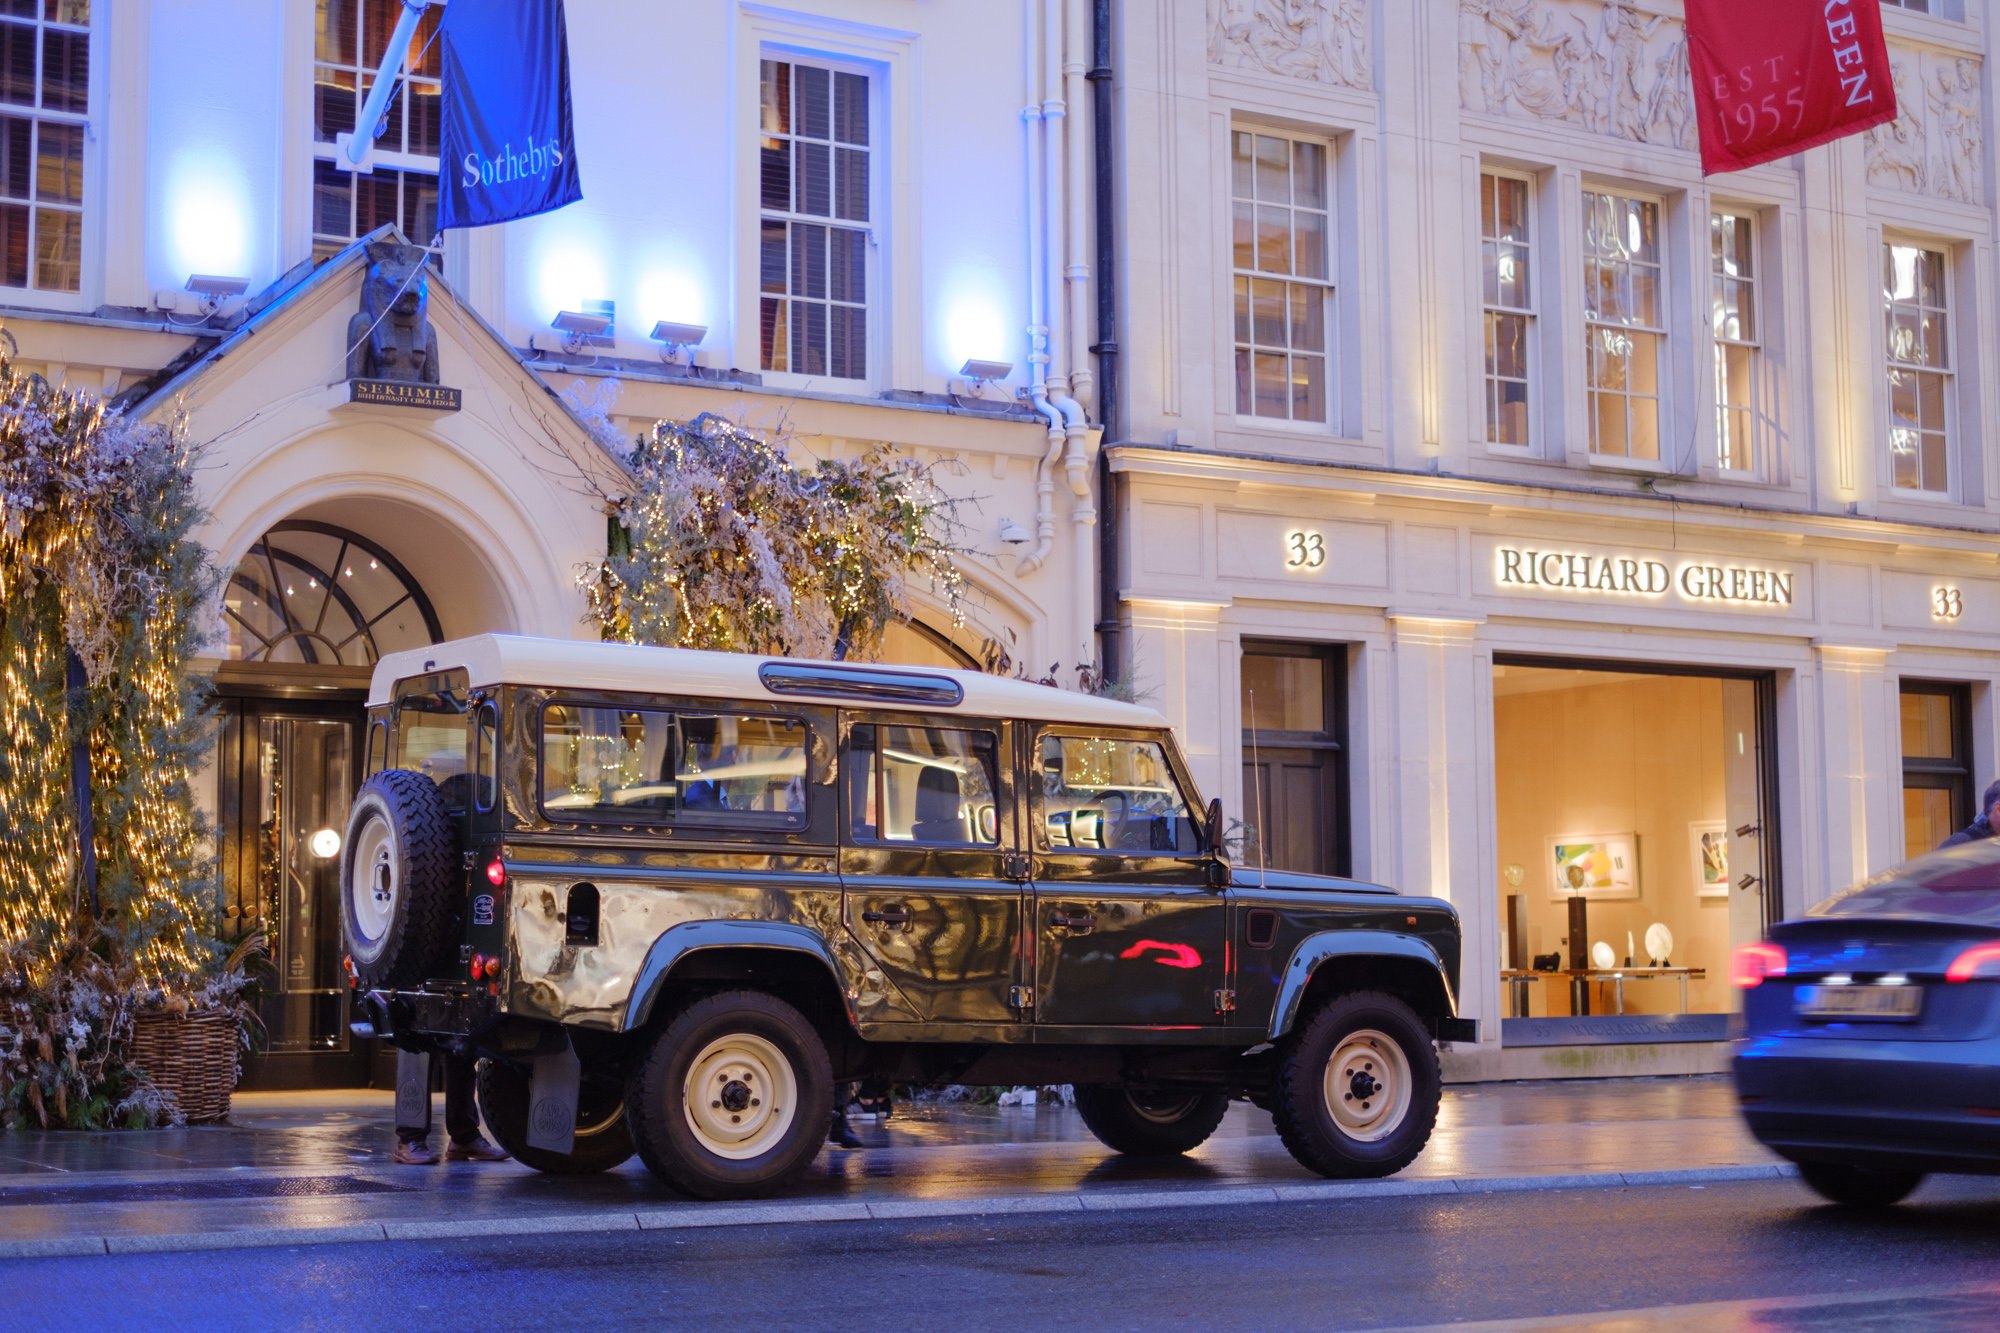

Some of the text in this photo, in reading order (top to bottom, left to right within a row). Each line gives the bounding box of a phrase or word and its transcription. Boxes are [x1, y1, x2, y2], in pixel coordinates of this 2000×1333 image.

[1712, 55, 1800, 100] EST.
[1718, 86, 1804, 146] 1955
[462, 135, 563, 188] Sotheby's
[358, 383, 458, 400] SEKHMET
[376, 394, 408, 403] DYNASTY
[410, 397, 431, 405] CIRCA
[1288, 532, 1325, 568] 33
[1501, 549, 1794, 604] RICHARD GREEN
[1933, 587, 1963, 619] 33
[1570, 1022, 1651, 1037] RICHARD
[1655, 1020, 1713, 1034] GREEN
